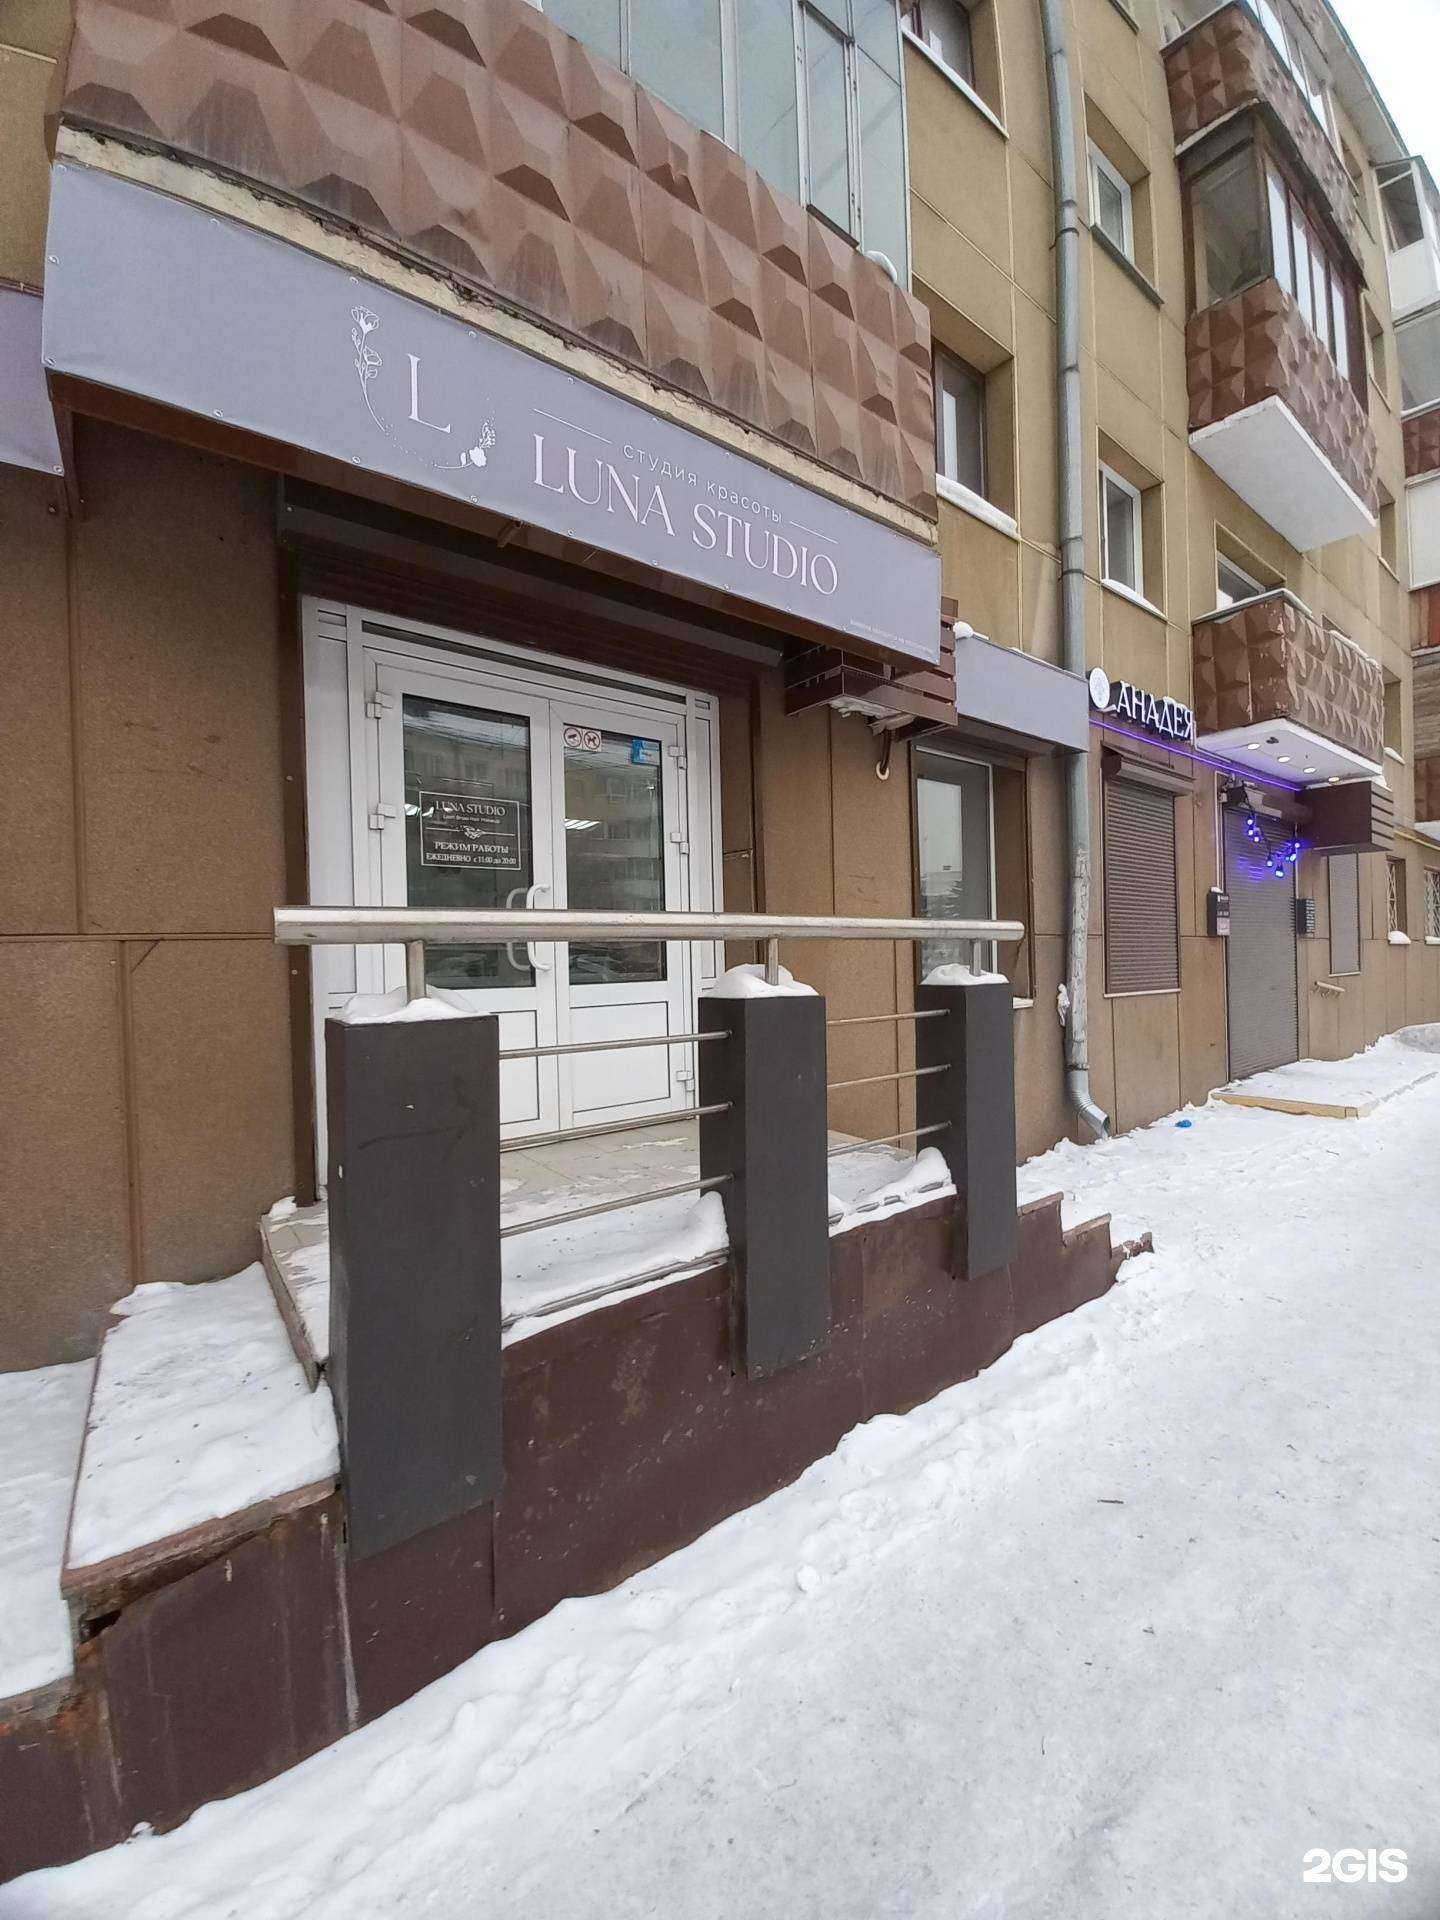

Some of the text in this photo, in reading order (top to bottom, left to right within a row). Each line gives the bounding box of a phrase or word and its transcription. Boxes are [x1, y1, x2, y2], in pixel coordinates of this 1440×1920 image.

[406, 352, 452, 434] L
[533, 434, 839, 595] LUNA STUDIO
[623, 444, 782, 523] студия красоты
[1116, 680, 1194, 742] АНАДЕЯ
[466, 803, 506, 816] STUDIO
[434, 841, 509, 854] РЕЖИМ РАБОТЫ
